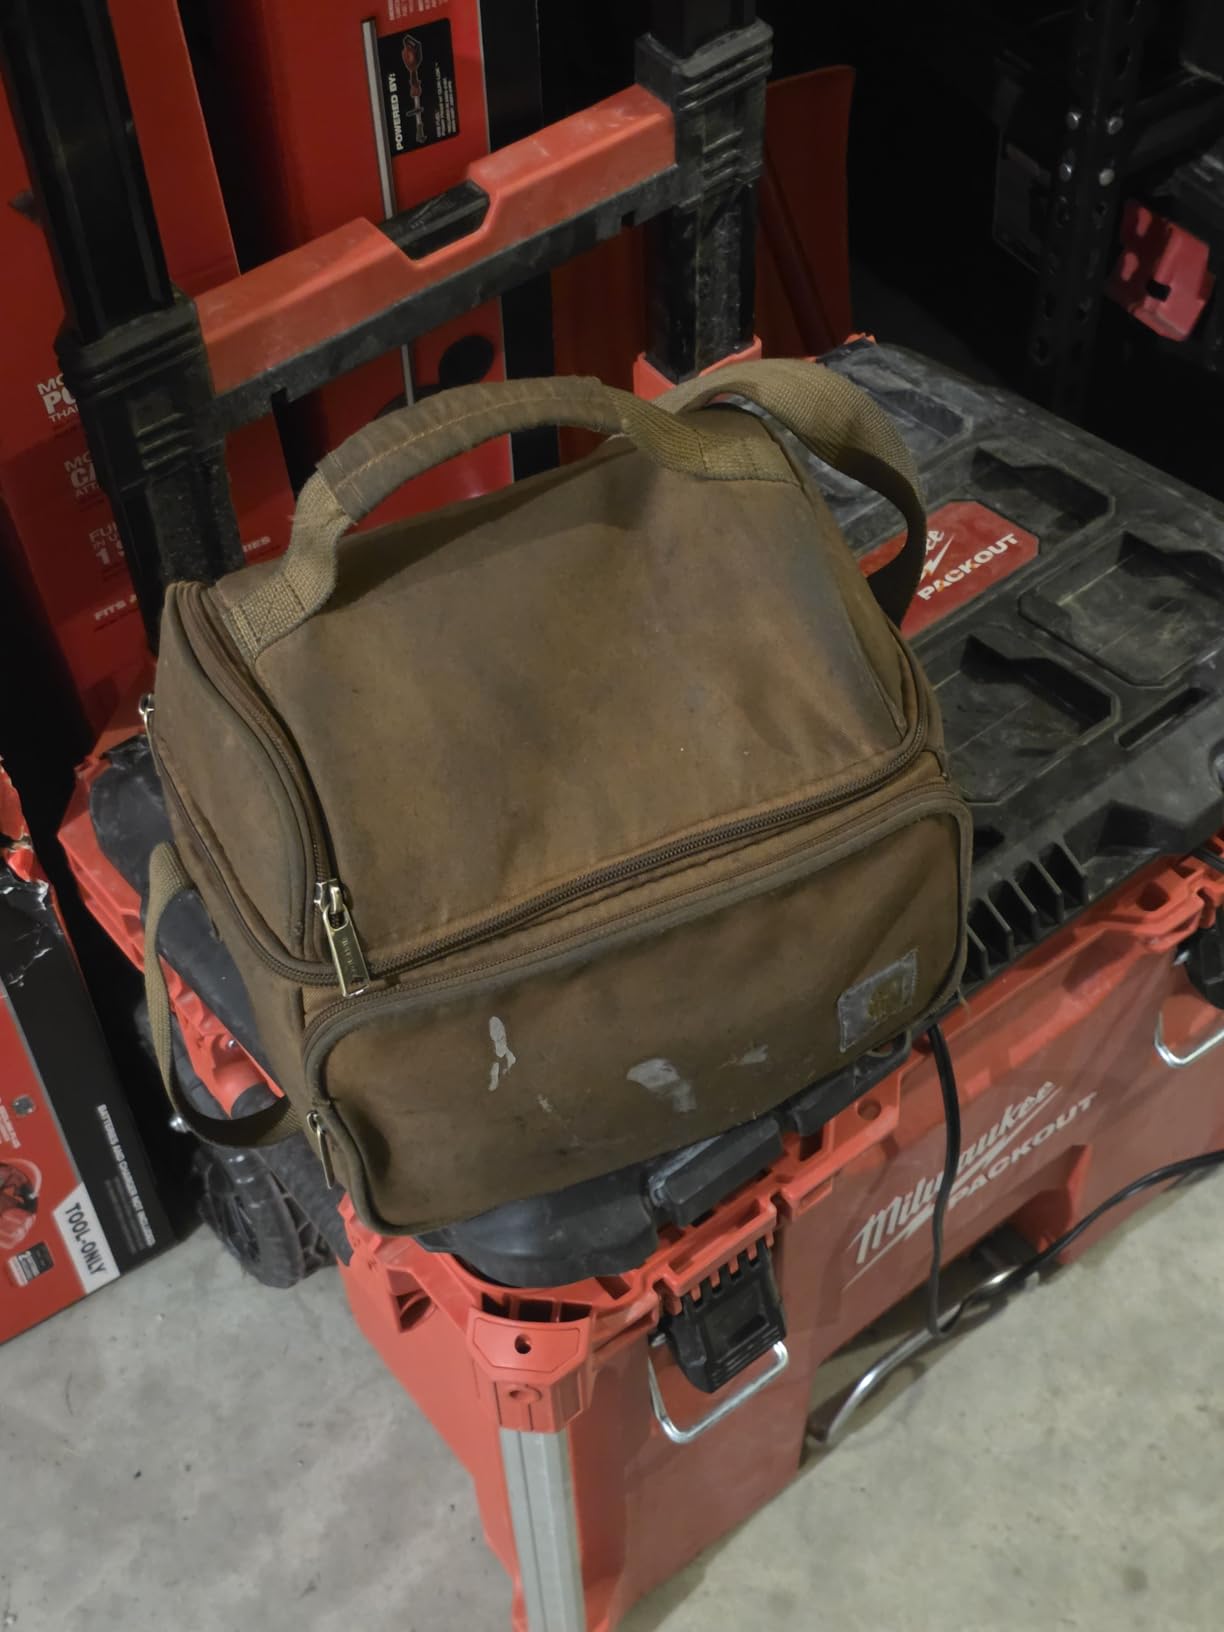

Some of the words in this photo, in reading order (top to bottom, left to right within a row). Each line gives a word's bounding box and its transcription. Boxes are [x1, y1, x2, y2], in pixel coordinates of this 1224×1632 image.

[390, 94, 404, 151] POWERED
[917, 533, 1018, 600] PACKOUT
[948, 1092, 1097, 1210] PACKOUT
[65, 1202, 106, 1275] TOOL-ONLY
